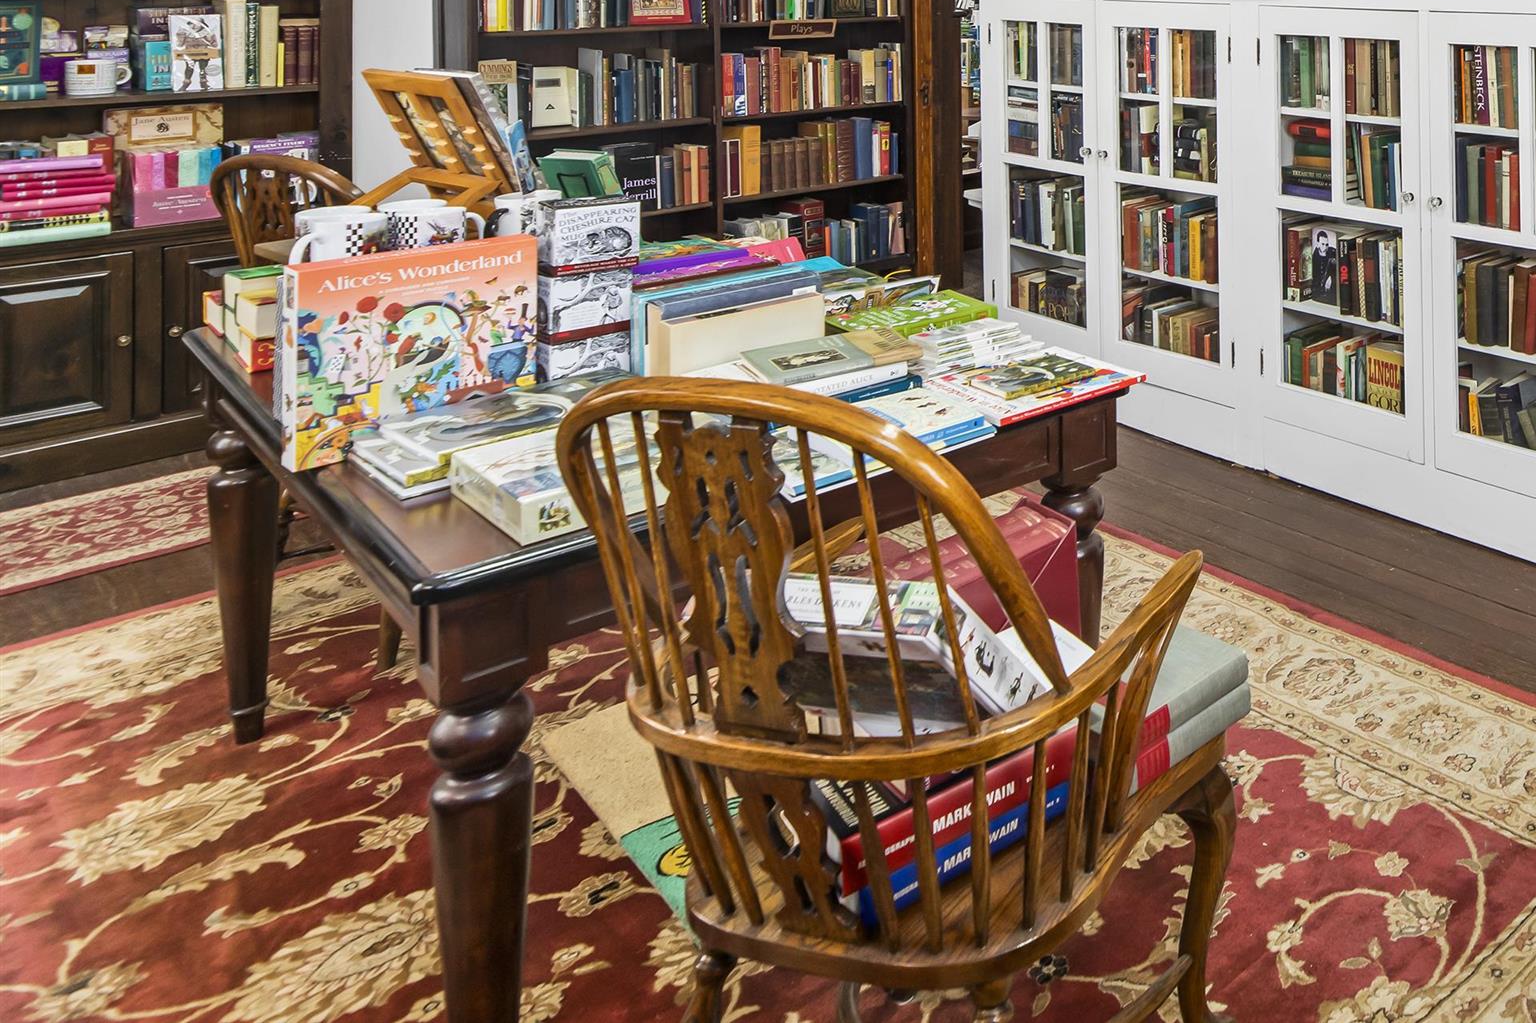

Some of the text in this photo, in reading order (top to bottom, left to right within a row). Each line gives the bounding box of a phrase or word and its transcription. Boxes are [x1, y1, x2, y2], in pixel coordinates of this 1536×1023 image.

[790, 24, 813, 36] Plays
[479, 63, 513, 73] CUMMINGS
[1474, 46, 1485, 111] STEINBECK
[135, 114, 190, 125] Jane Austen
[623, 176, 656, 190] James
[559, 207, 637, 226] DISAPPEARING
[561, 216, 635, 234] CHESHIRE CAT
[318, 272, 393, 294] Alice's
[398, 250, 523, 280] Wonderland
[933, 781, 1015, 834] MARK WAIN
[943, 846, 972, 874] MAR
[988, 818, 1019, 844] WAIN
